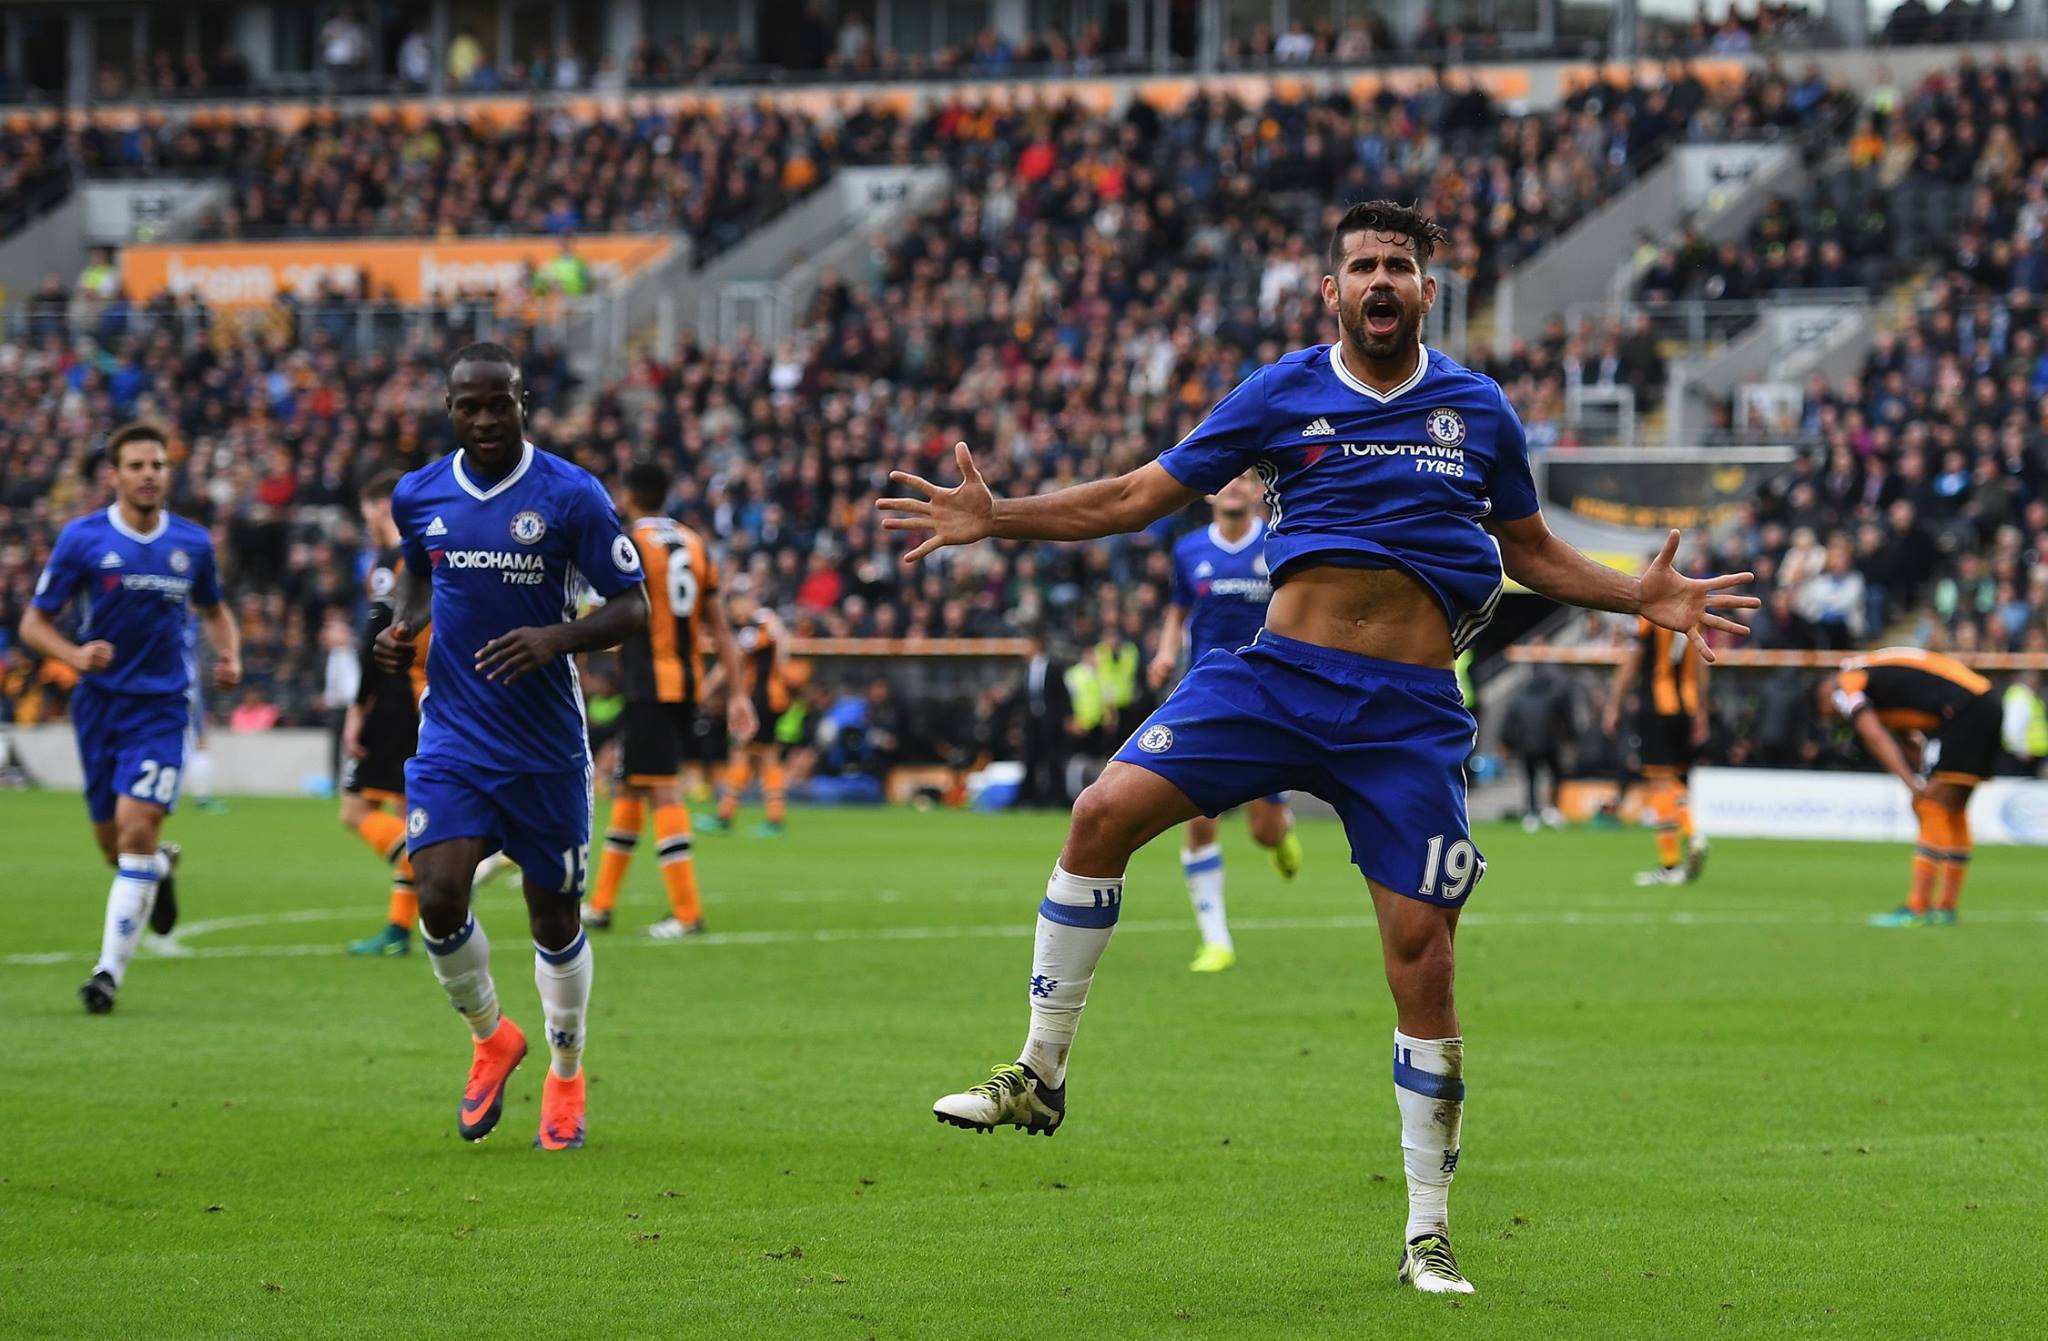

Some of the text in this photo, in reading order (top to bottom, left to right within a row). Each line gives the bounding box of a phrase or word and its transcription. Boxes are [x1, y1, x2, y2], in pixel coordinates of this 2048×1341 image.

[1302, 427, 1335, 436] adidas
[1416, 459, 1464, 478] TYRES
[445, 550, 545, 571] YOKOHAMA
[502, 571, 544, 585] TYRES
[666, 547, 699, 618] 6
[1418, 834, 1476, 899] 19
